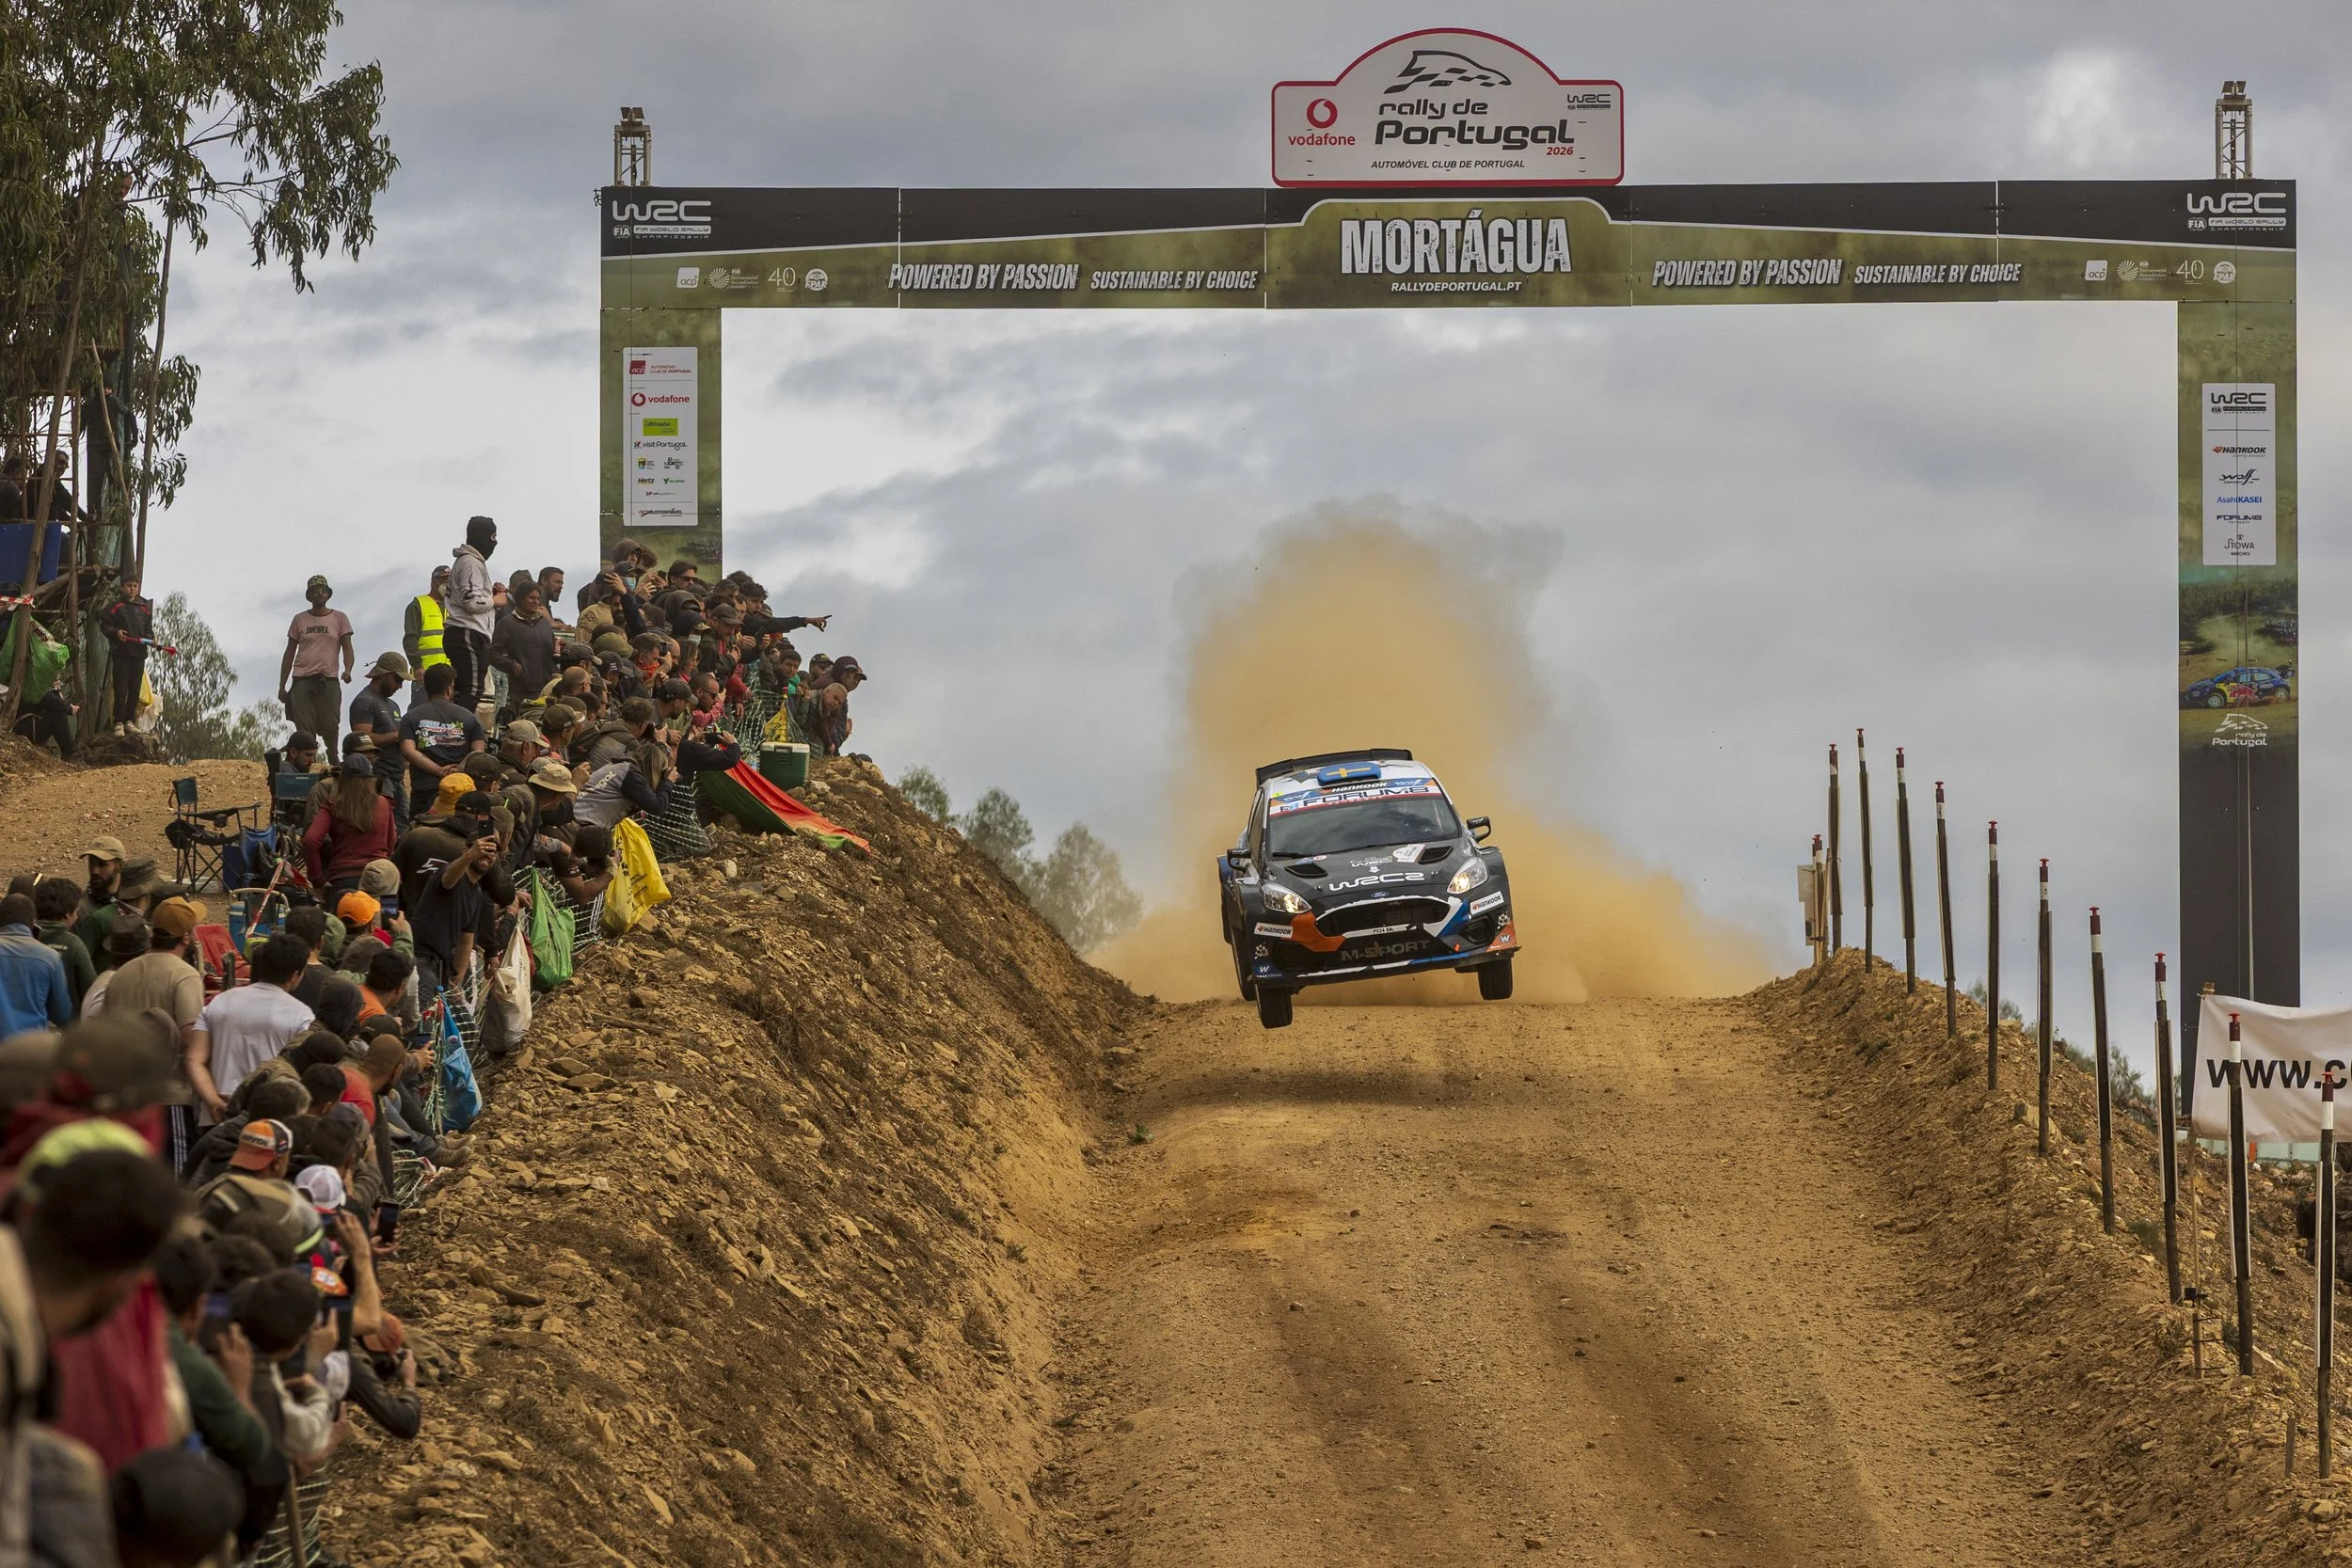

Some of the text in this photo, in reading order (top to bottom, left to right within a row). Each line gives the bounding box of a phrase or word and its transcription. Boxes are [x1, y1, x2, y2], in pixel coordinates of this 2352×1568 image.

[1567, 94, 1611, 103] WRC
[1378, 99, 1488, 119] rally de
[1288, 133, 1356, 146] vodafone
[1375, 119, 1574, 150] Portugal
[1546, 147, 1574, 156] 2026
[1371, 159, 1525, 169] AUTOMÓVEL CLUB DE PORTUGAL
[612, 200, 711, 221] WRC
[2187, 193, 2286, 214] WRC
[1342, 209, 1572, 274] MORTÁGUA
[768, 267, 796, 286] 40
[887, 263, 1079, 289] POWERED BY PASSION
[1090, 270, 1258, 289] SUSTAINABLE BY CHOICE
[1652, 259, 1842, 286] POWERED BY PASSION
[1853, 263, 2022, 283] SUSTAINABLE BY CHOICE
[2176, 261, 2203, 279] 40
[1391, 281, 1522, 293] RALLYDEPORTUGAL.PT
[2211, 392, 2266, 404] WRC
[656, 441, 688, 451] Portugal
[2212, 737, 2267, 747] Portugal
[1304, 786, 1429, 806] FORUM8
[1328, 872, 1425, 892] WRC2
